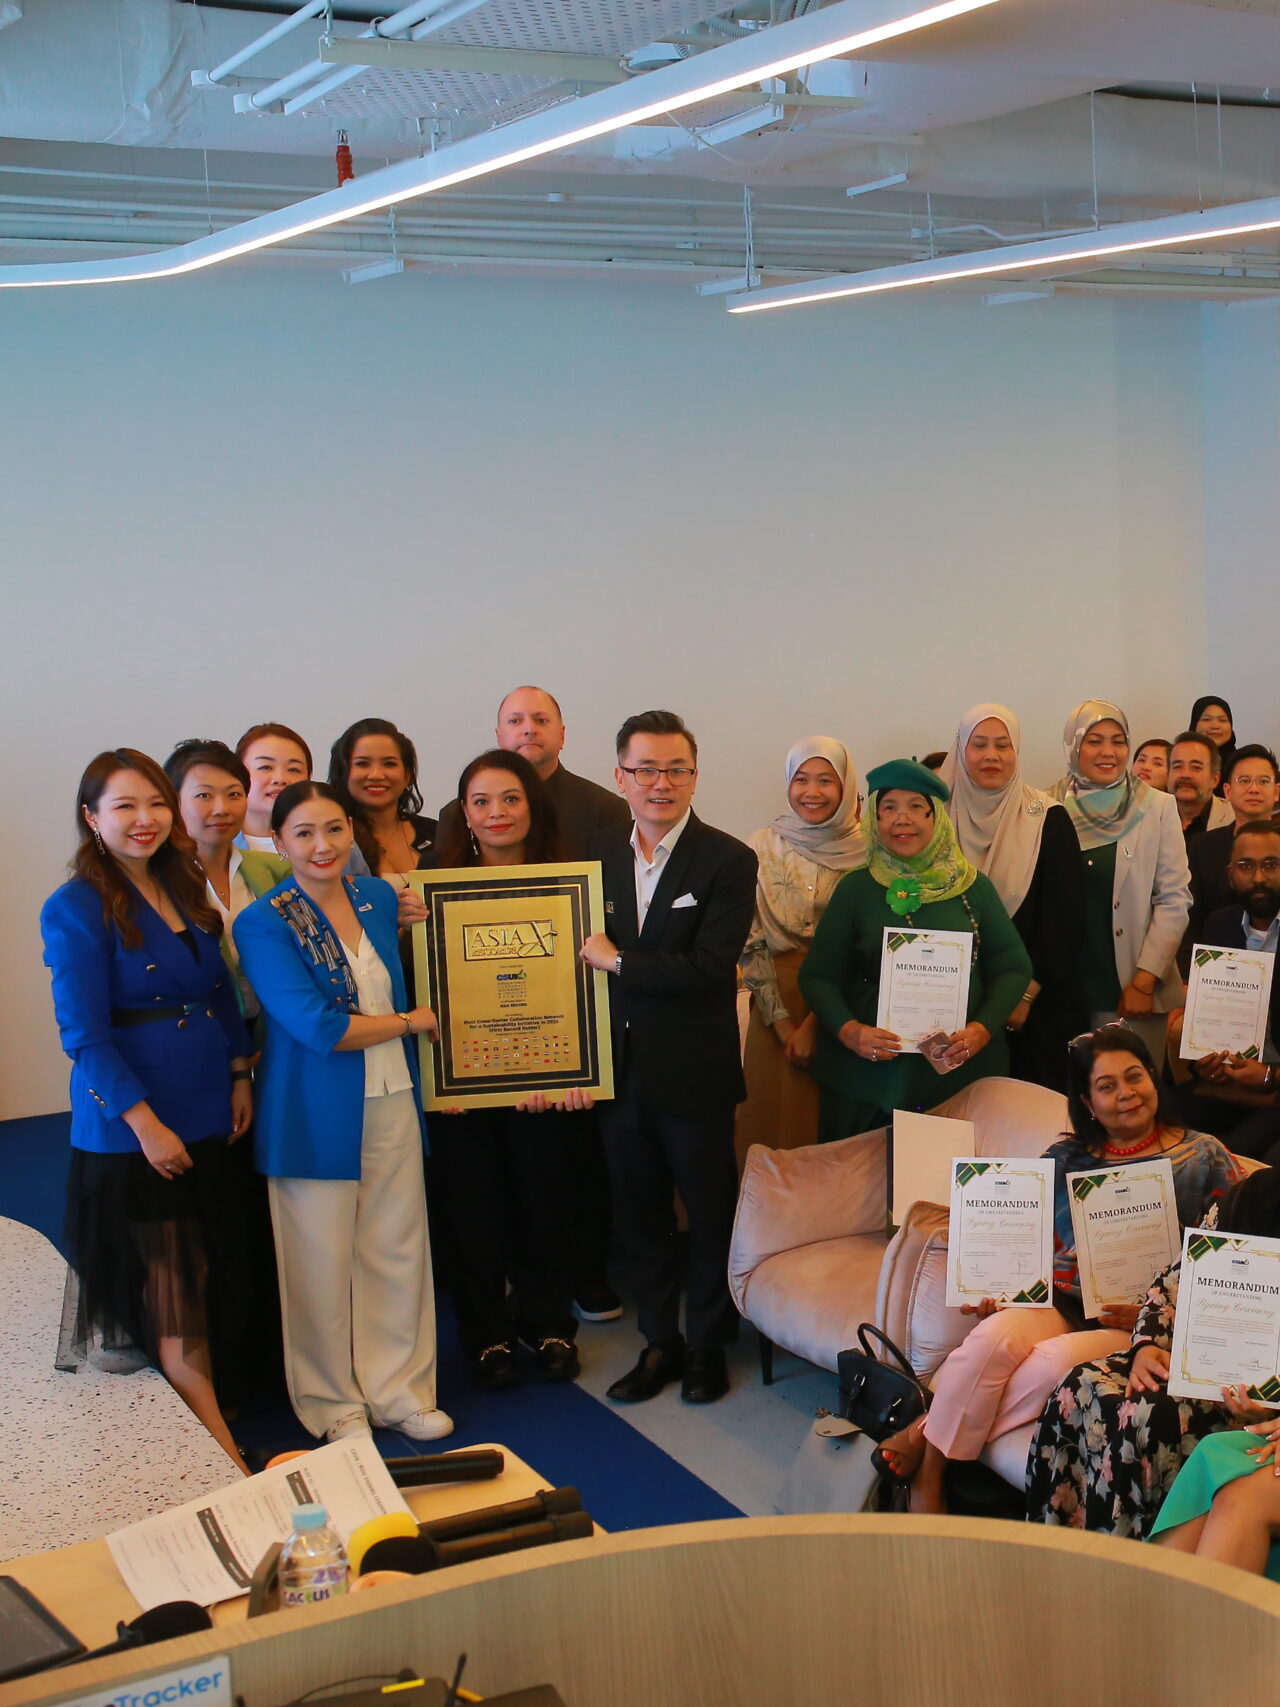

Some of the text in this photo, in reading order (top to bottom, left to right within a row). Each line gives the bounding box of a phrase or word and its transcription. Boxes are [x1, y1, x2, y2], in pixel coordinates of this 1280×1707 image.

[472, 928, 523, 948] ASIA
[896, 963, 958, 973] MEMORANDUM
[1201, 978, 1259, 990] MEMORANDUM
[966, 1200, 1038, 1208] MEMORANDUM
[1089, 1202, 1162, 1220] MEMORANDUM
[1197, 1277, 1280, 1295] MEMORANDUM
[105, 1672, 222, 1707] Tracker
